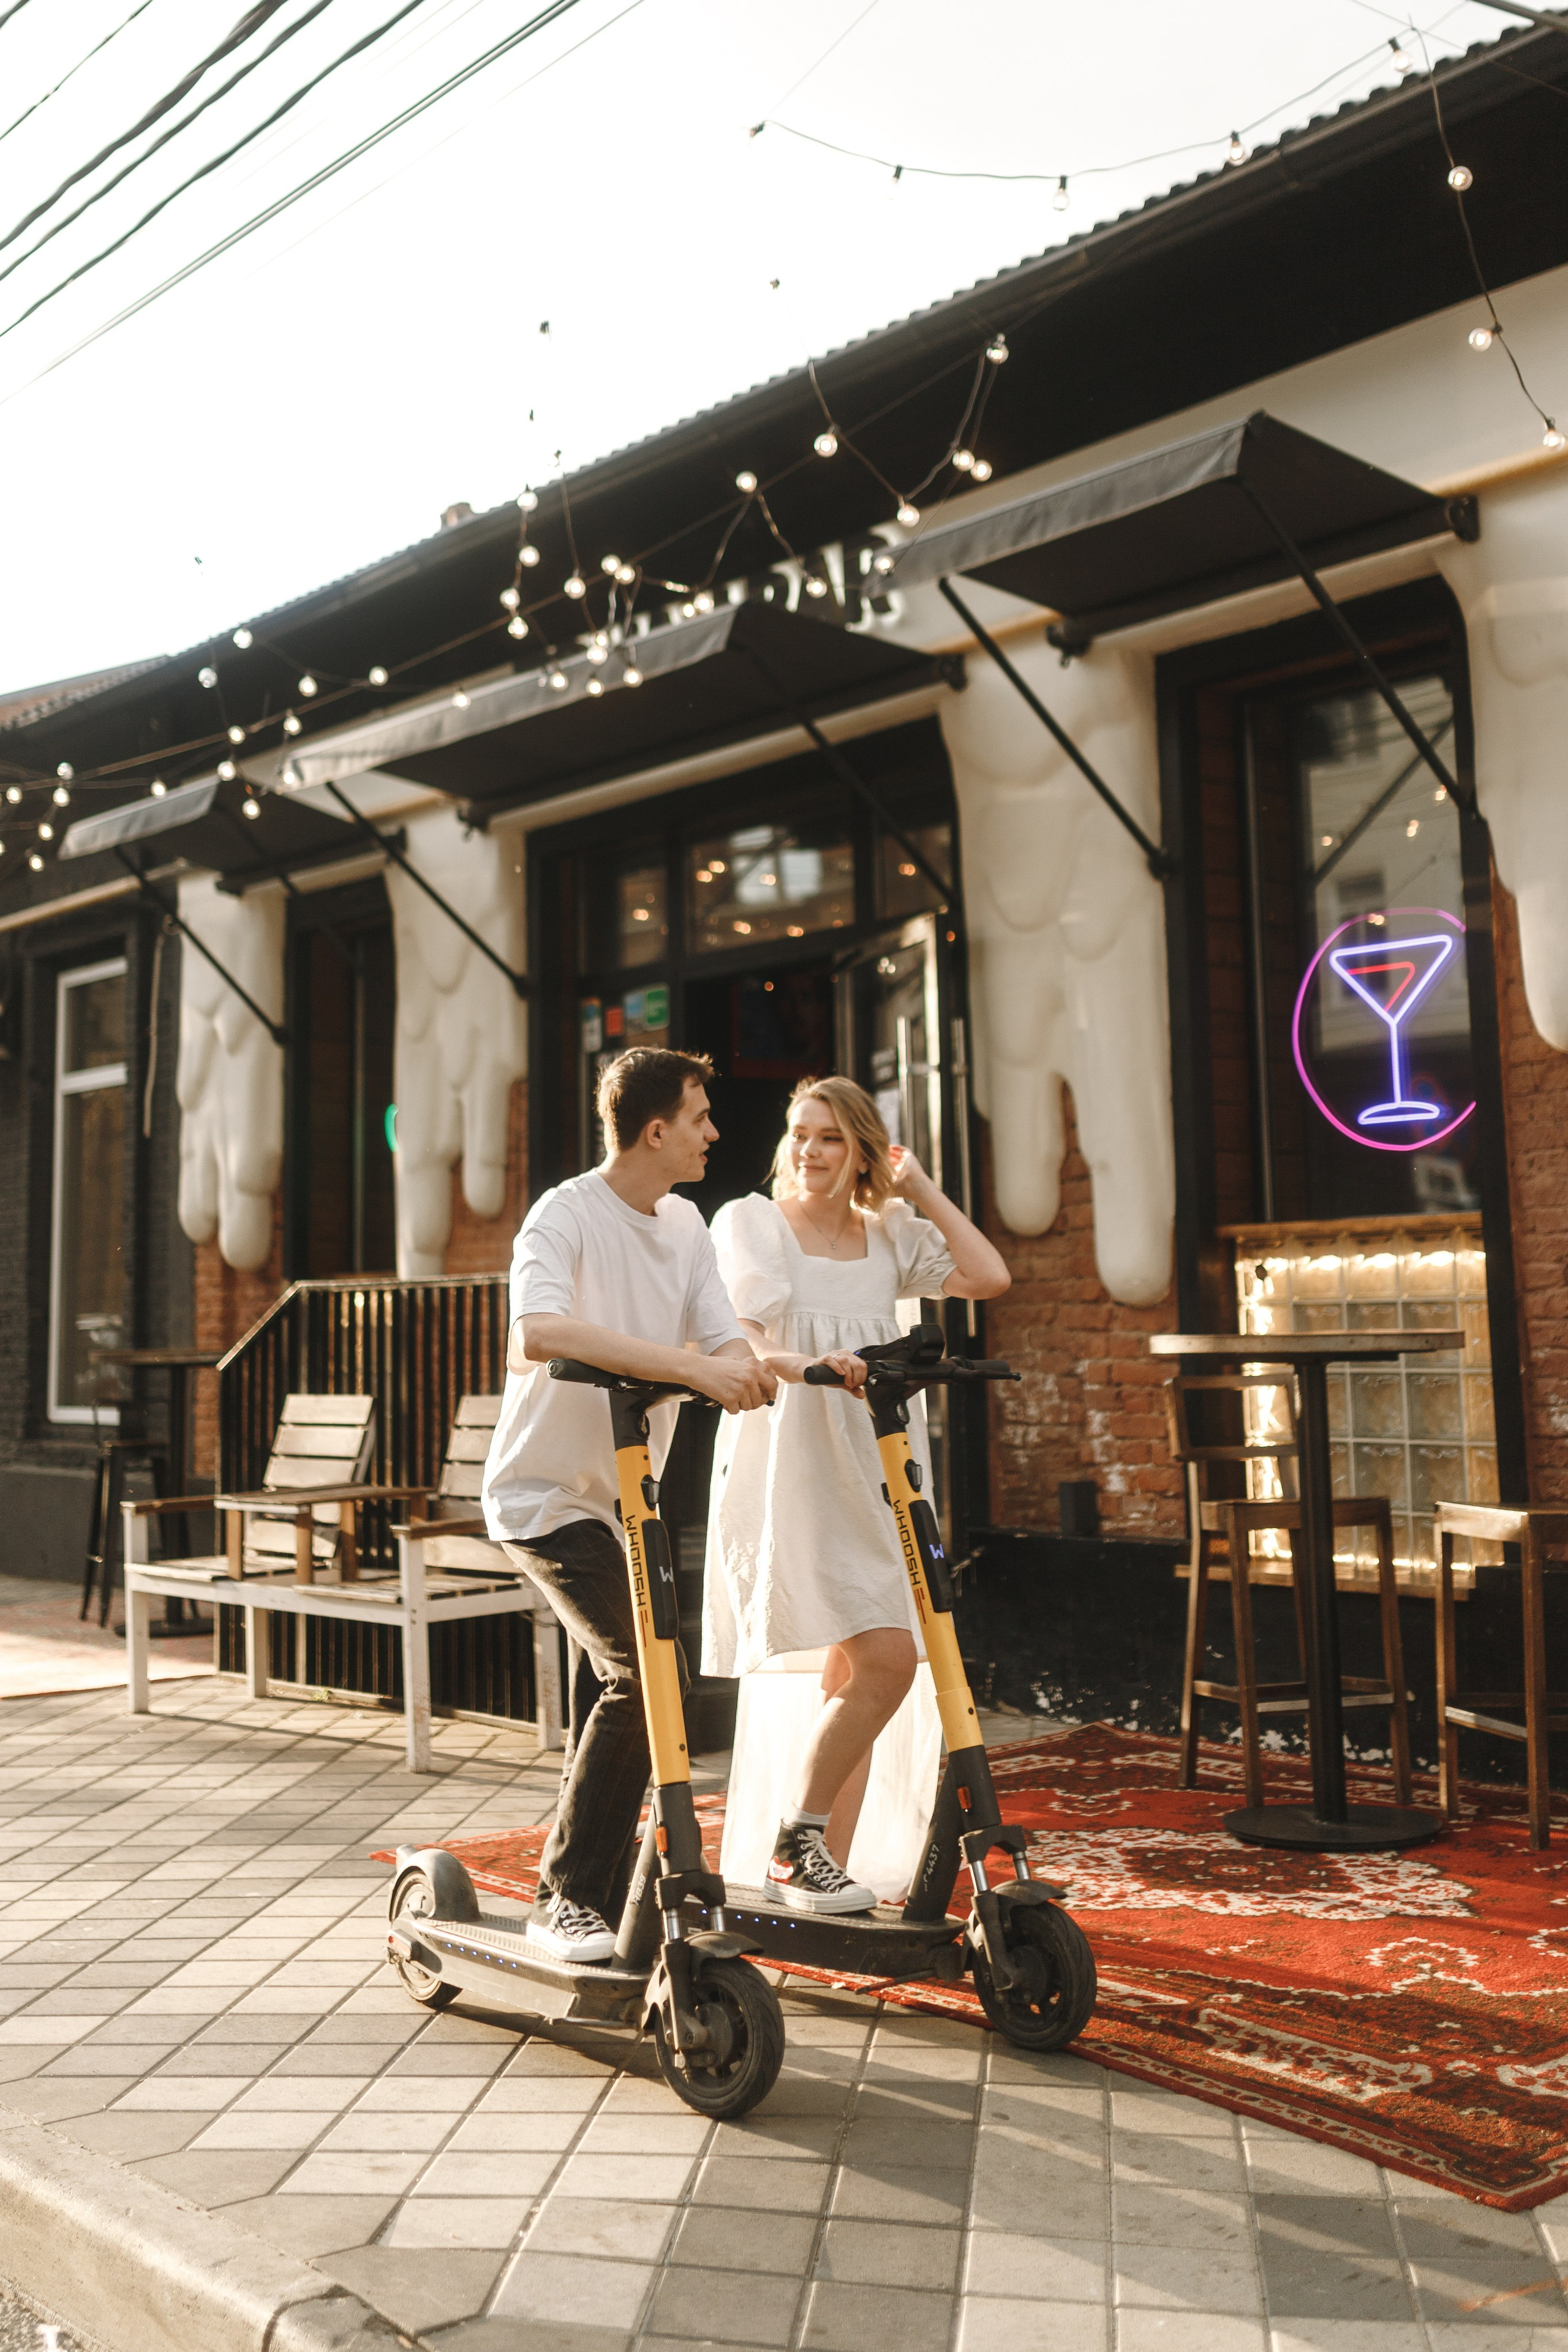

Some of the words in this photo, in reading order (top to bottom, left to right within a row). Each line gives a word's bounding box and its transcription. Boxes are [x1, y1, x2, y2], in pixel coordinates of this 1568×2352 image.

[625, 1514, 647, 1607] WHOOSH
[892, 1499, 921, 1586] WHOOSH
[929, 1544, 944, 1559] W
[659, 1566, 674, 1583] W
